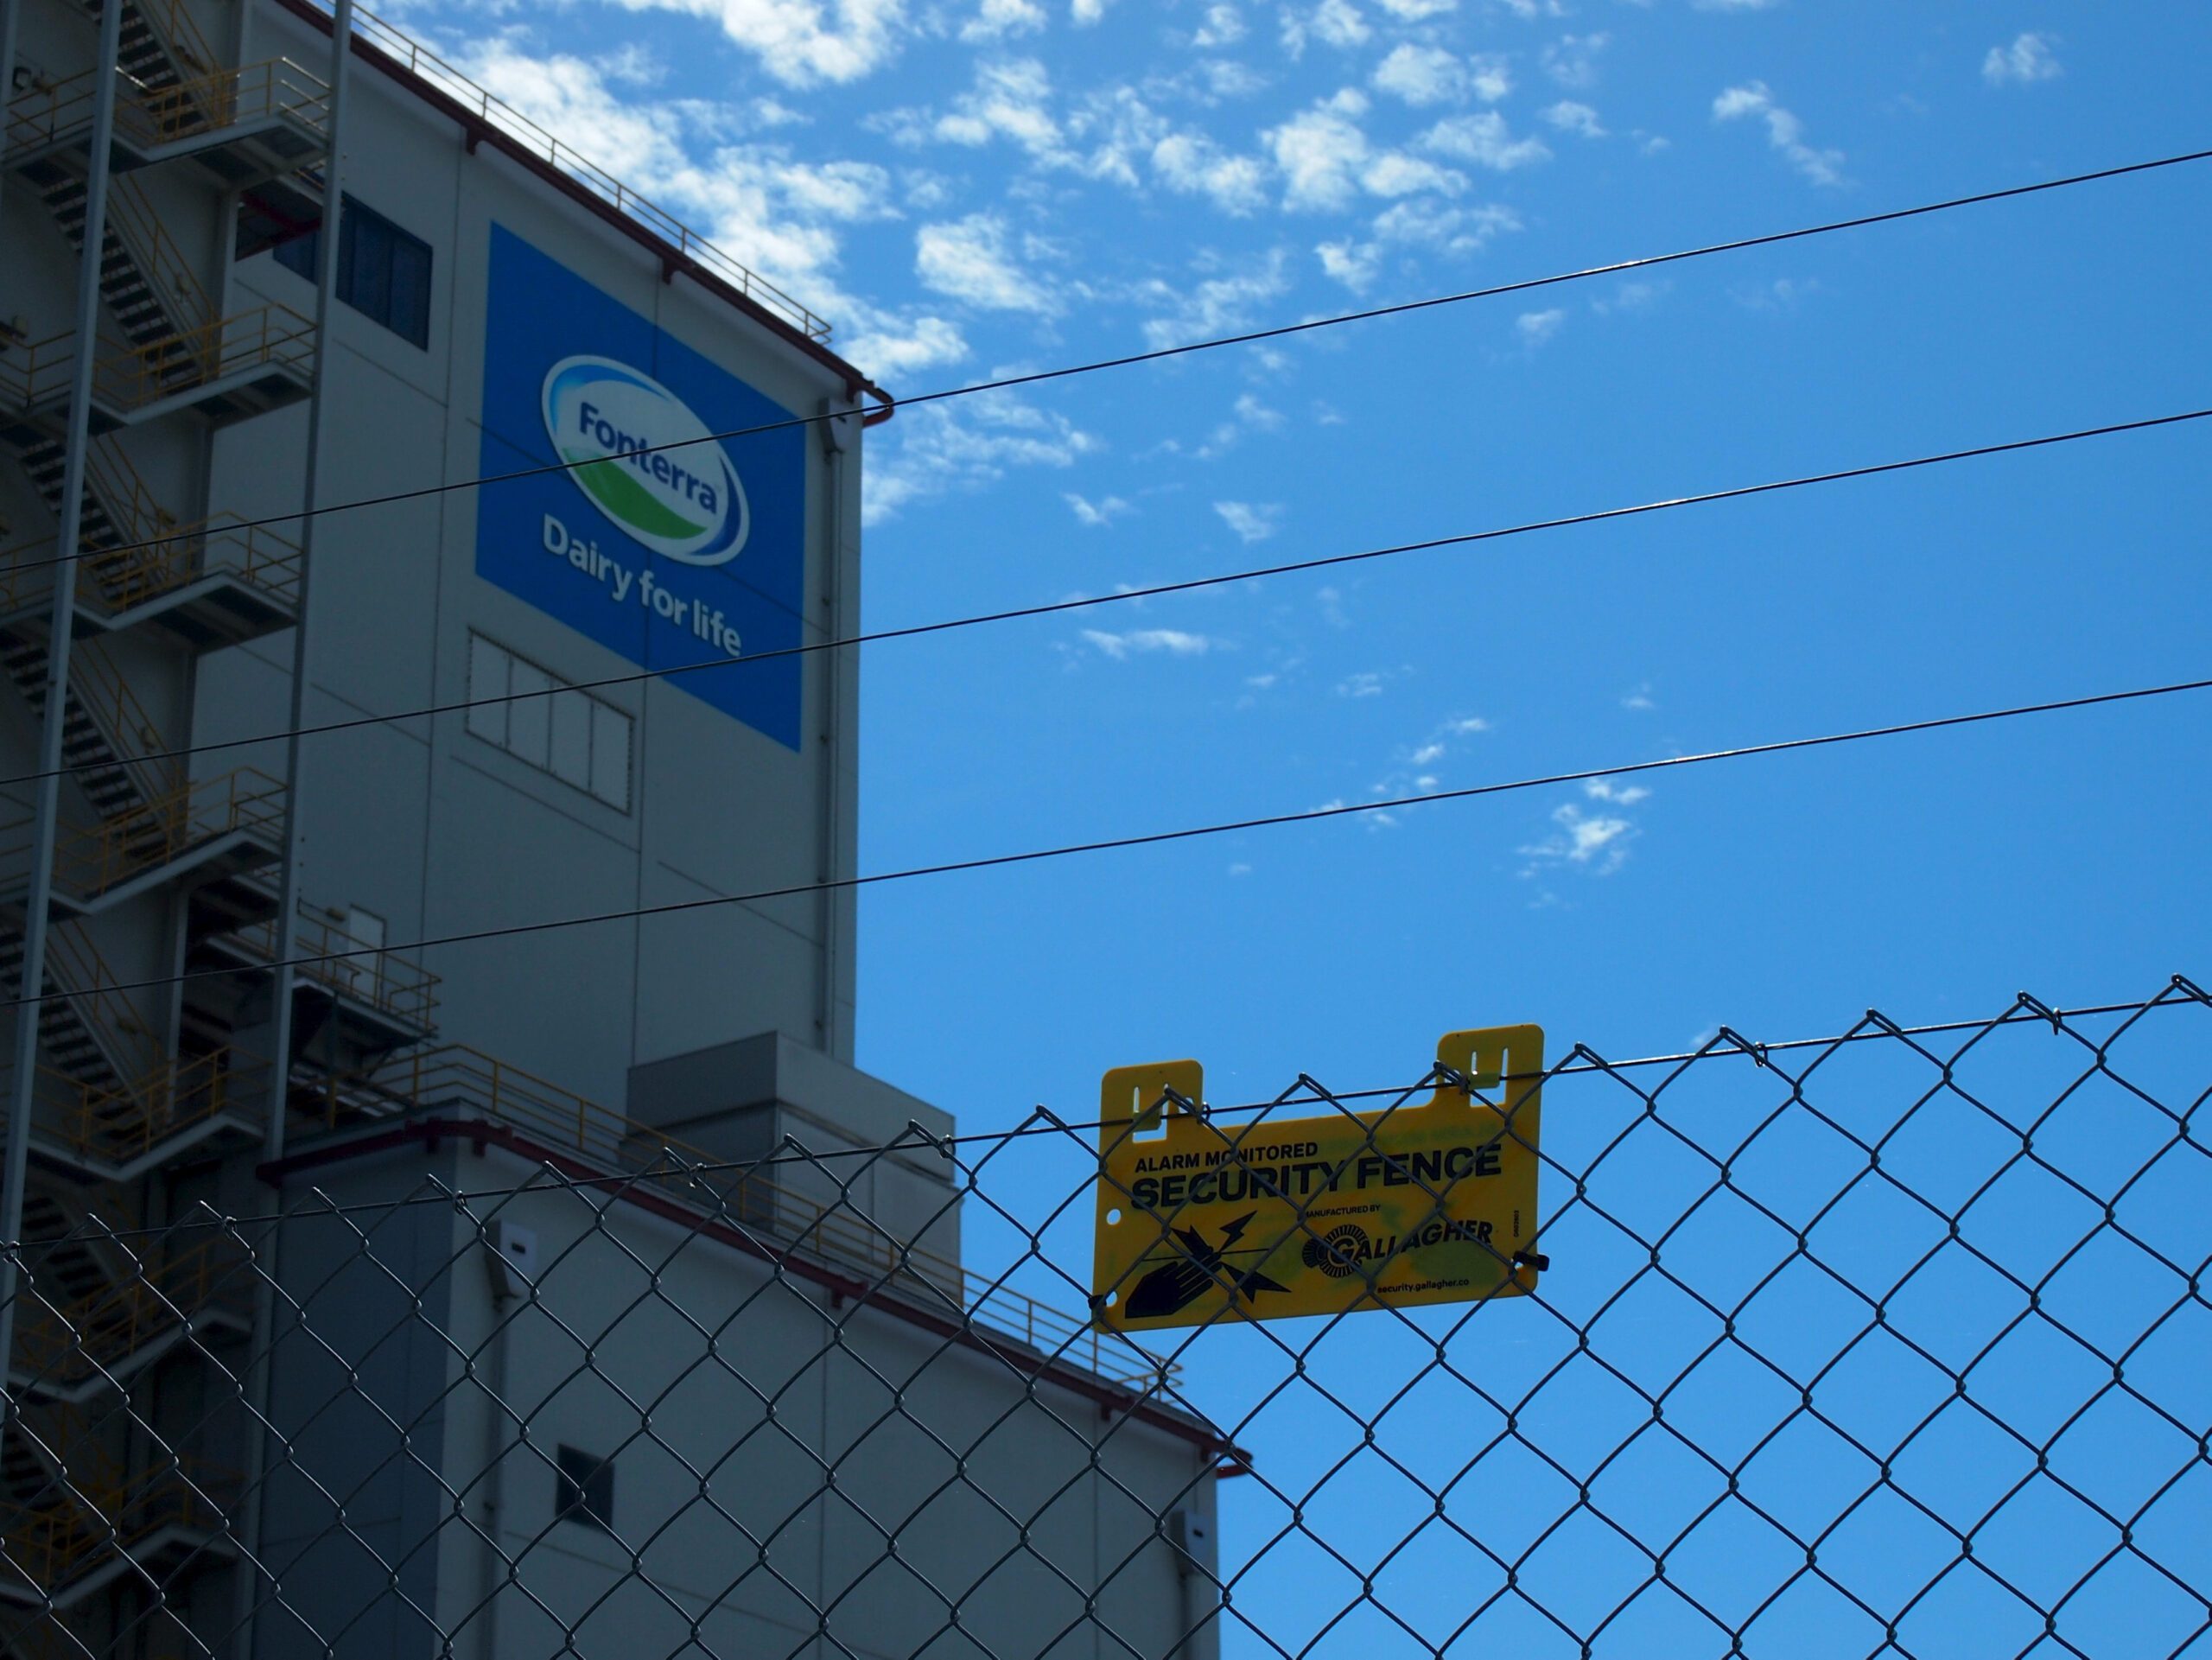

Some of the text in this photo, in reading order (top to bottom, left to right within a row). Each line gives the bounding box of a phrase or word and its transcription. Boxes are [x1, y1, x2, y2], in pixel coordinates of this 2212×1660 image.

[580, 402, 717, 514] Fonterra
[543, 513, 741, 657] Dairy for life
[1130, 1144, 1502, 1210] SECURITY FENCE
[1135, 1152, 1199, 1173] ALARM
[1370, 1204, 1381, 1212] BY
